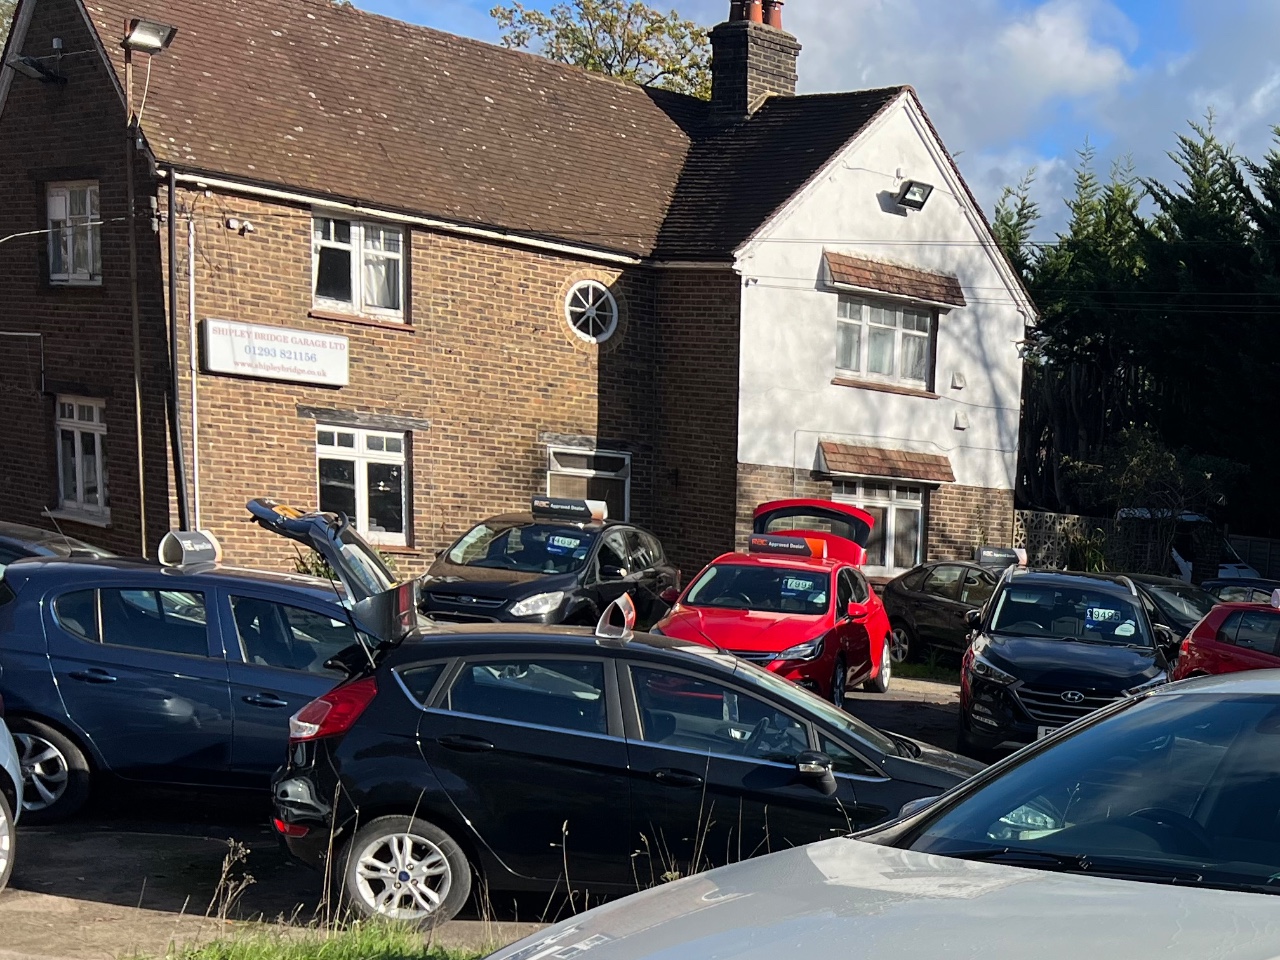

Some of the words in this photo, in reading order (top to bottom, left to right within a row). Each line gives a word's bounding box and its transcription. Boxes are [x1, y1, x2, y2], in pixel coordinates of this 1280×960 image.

[212, 326, 253, 339] SHIPLEY
[254, 331, 289, 344] BRIDGE
[290, 337, 327, 349] GARAGE
[329, 341, 346, 351] LTD
[244, 344, 277, 358] 01293
[280, 349, 317, 363] 821156
[233, 360, 327, 377] www.shipleybridge.co.uk
